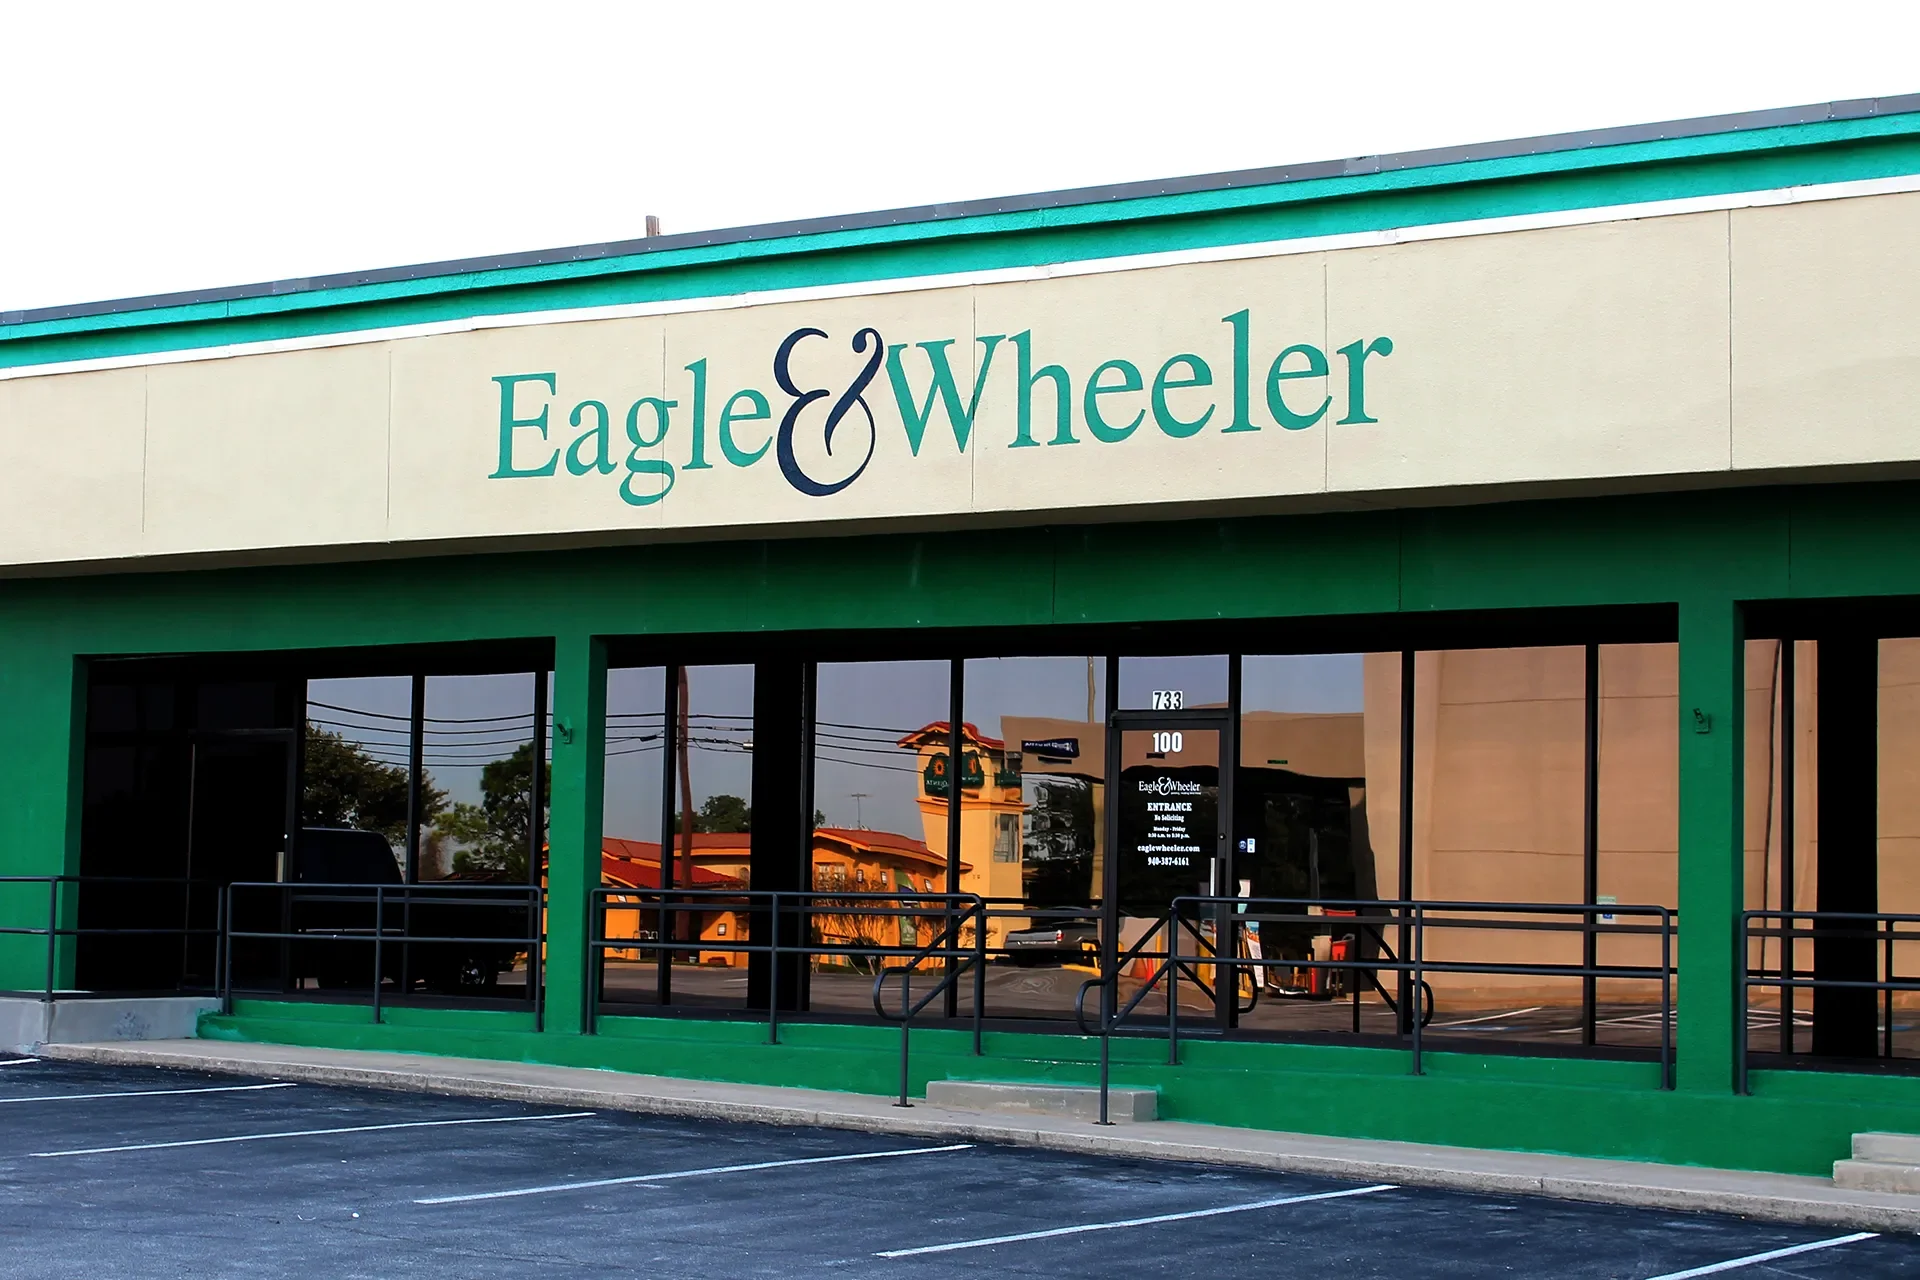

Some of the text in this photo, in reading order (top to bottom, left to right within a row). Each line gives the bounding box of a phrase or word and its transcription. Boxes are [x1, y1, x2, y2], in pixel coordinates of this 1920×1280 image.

[1154, 691, 1182, 710] 733
[1152, 732, 1183, 753] 100
[1147, 802, 1193, 812] ENTRANCE
[1137, 844, 1200, 853] eaglewheeler.com
[1147, 856, 1190, 866] 940-387-6161
